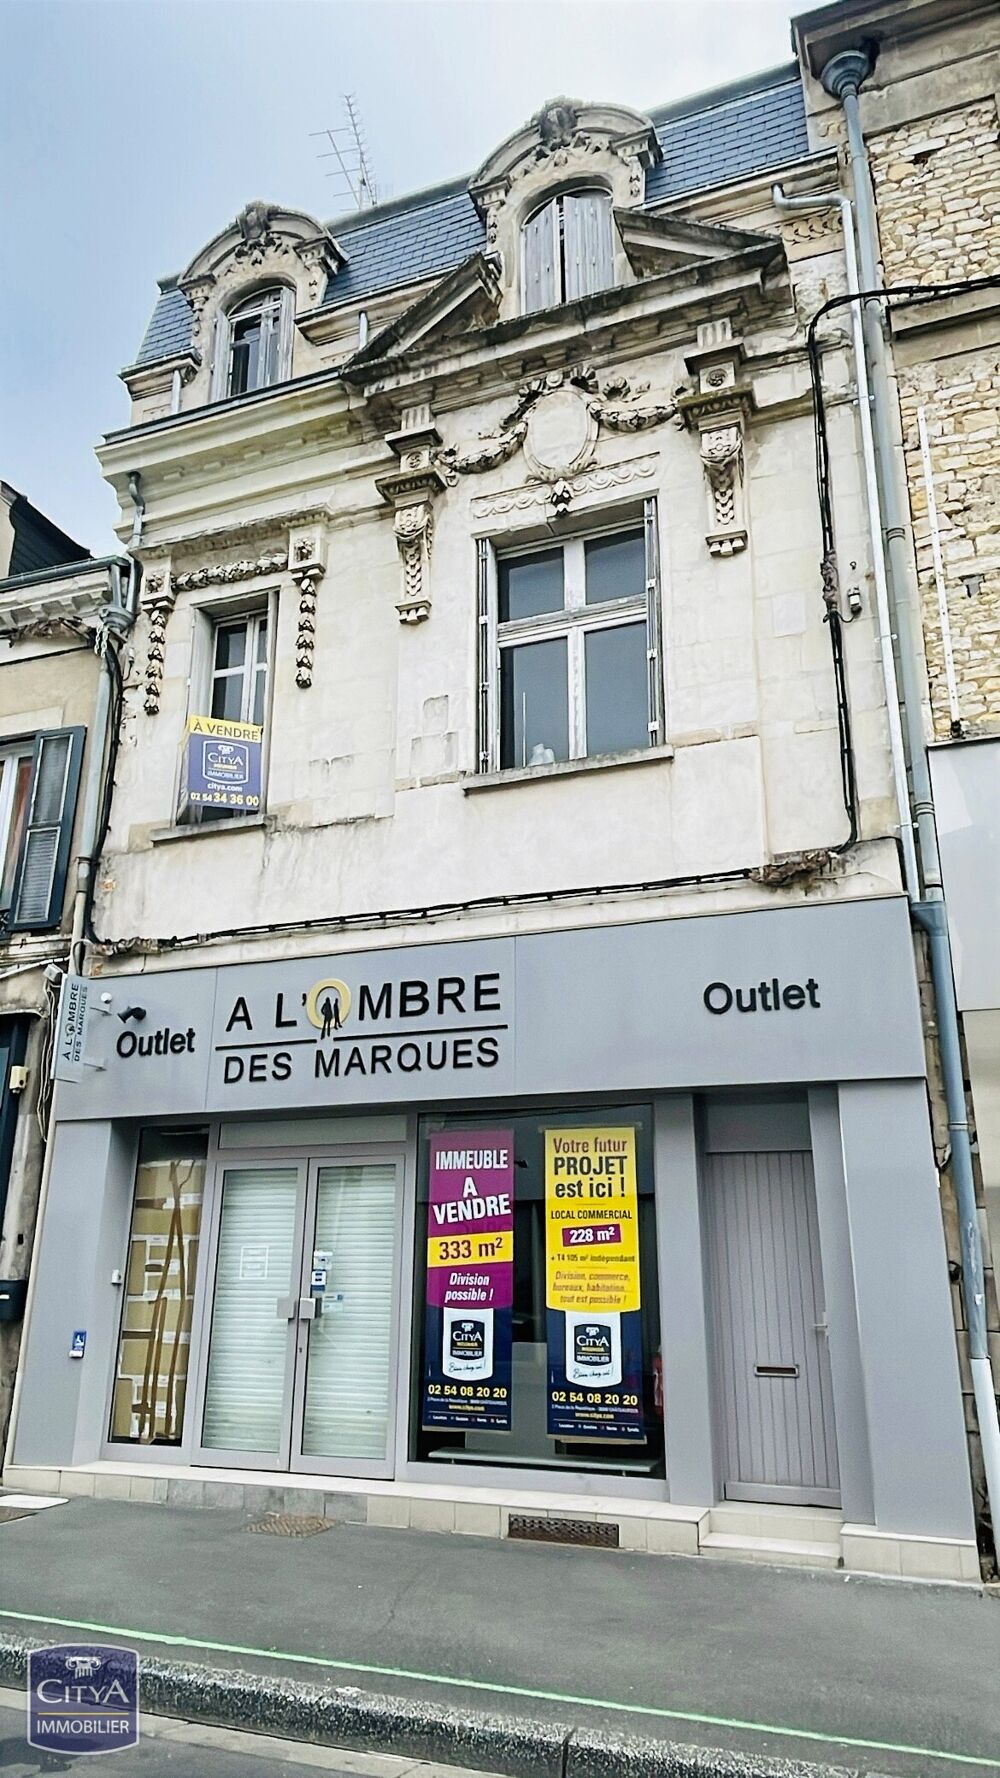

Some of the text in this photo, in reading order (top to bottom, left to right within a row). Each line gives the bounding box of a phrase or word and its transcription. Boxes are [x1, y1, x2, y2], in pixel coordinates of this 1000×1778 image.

[207, 723, 259, 741] VENDRE
[207, 782, 243, 792] citya.com
[190, 792, 259, 806] 02 54 34 36 00
[703, 978, 821, 1015] Outlet
[77, 985, 88, 1036] MARQUES
[225, 996, 253, 1032] A
[116, 1027, 196, 1059] Outlet
[62, 1051, 71, 1061] A
[224, 1037, 499, 1084] DES MARQUES
[553, 1137, 628, 1154] Votre futur
[435, 1149, 509, 1170] IMMEUBLE
[554, 1155, 628, 1176] PROJET
[462, 1176, 478, 1198] A
[555, 1179, 583, 1198] est
[589, 1177, 613, 1198] ici
[432, 1193, 512, 1225] VENDRE
[551, 1209, 633, 1220] LOCAL COMMERCIAL
[569, 1228, 594, 1244] 228
[438, 1239, 472, 1260] 333
[449, 1272, 490, 1286] Division
[444, 1288, 487, 1303] possible
[428, 1384, 507, 1399] 02 54 08 20 20
[551, 1391, 638, 1406] 02 54 08 20 20
